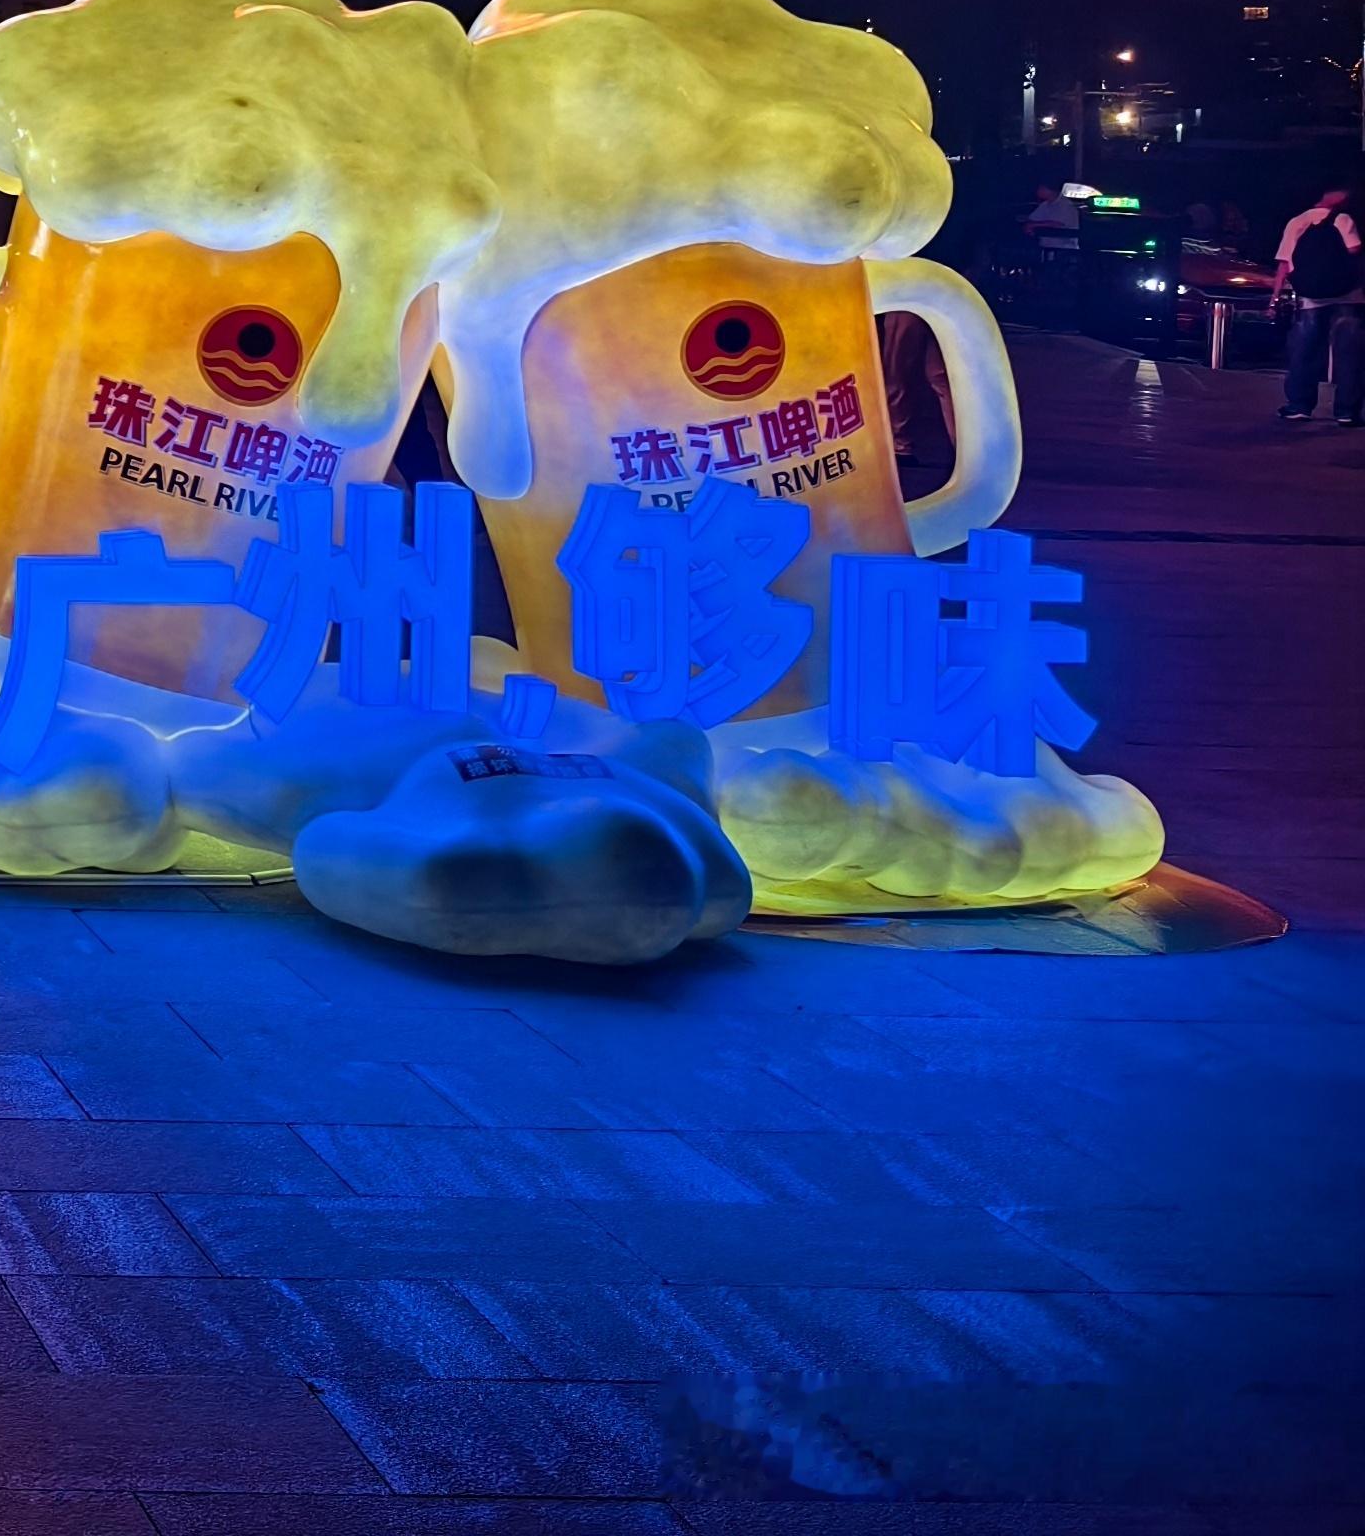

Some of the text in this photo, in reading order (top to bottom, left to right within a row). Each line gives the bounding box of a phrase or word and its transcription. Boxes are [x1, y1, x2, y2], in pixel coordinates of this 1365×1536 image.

[88, 375, 344, 486] 珠江啤酒
[610, 372, 865, 485] 珠江啤酒
[771, 447, 856, 498] RIVER
[100, 446, 279, 521] PEARL RIVE
